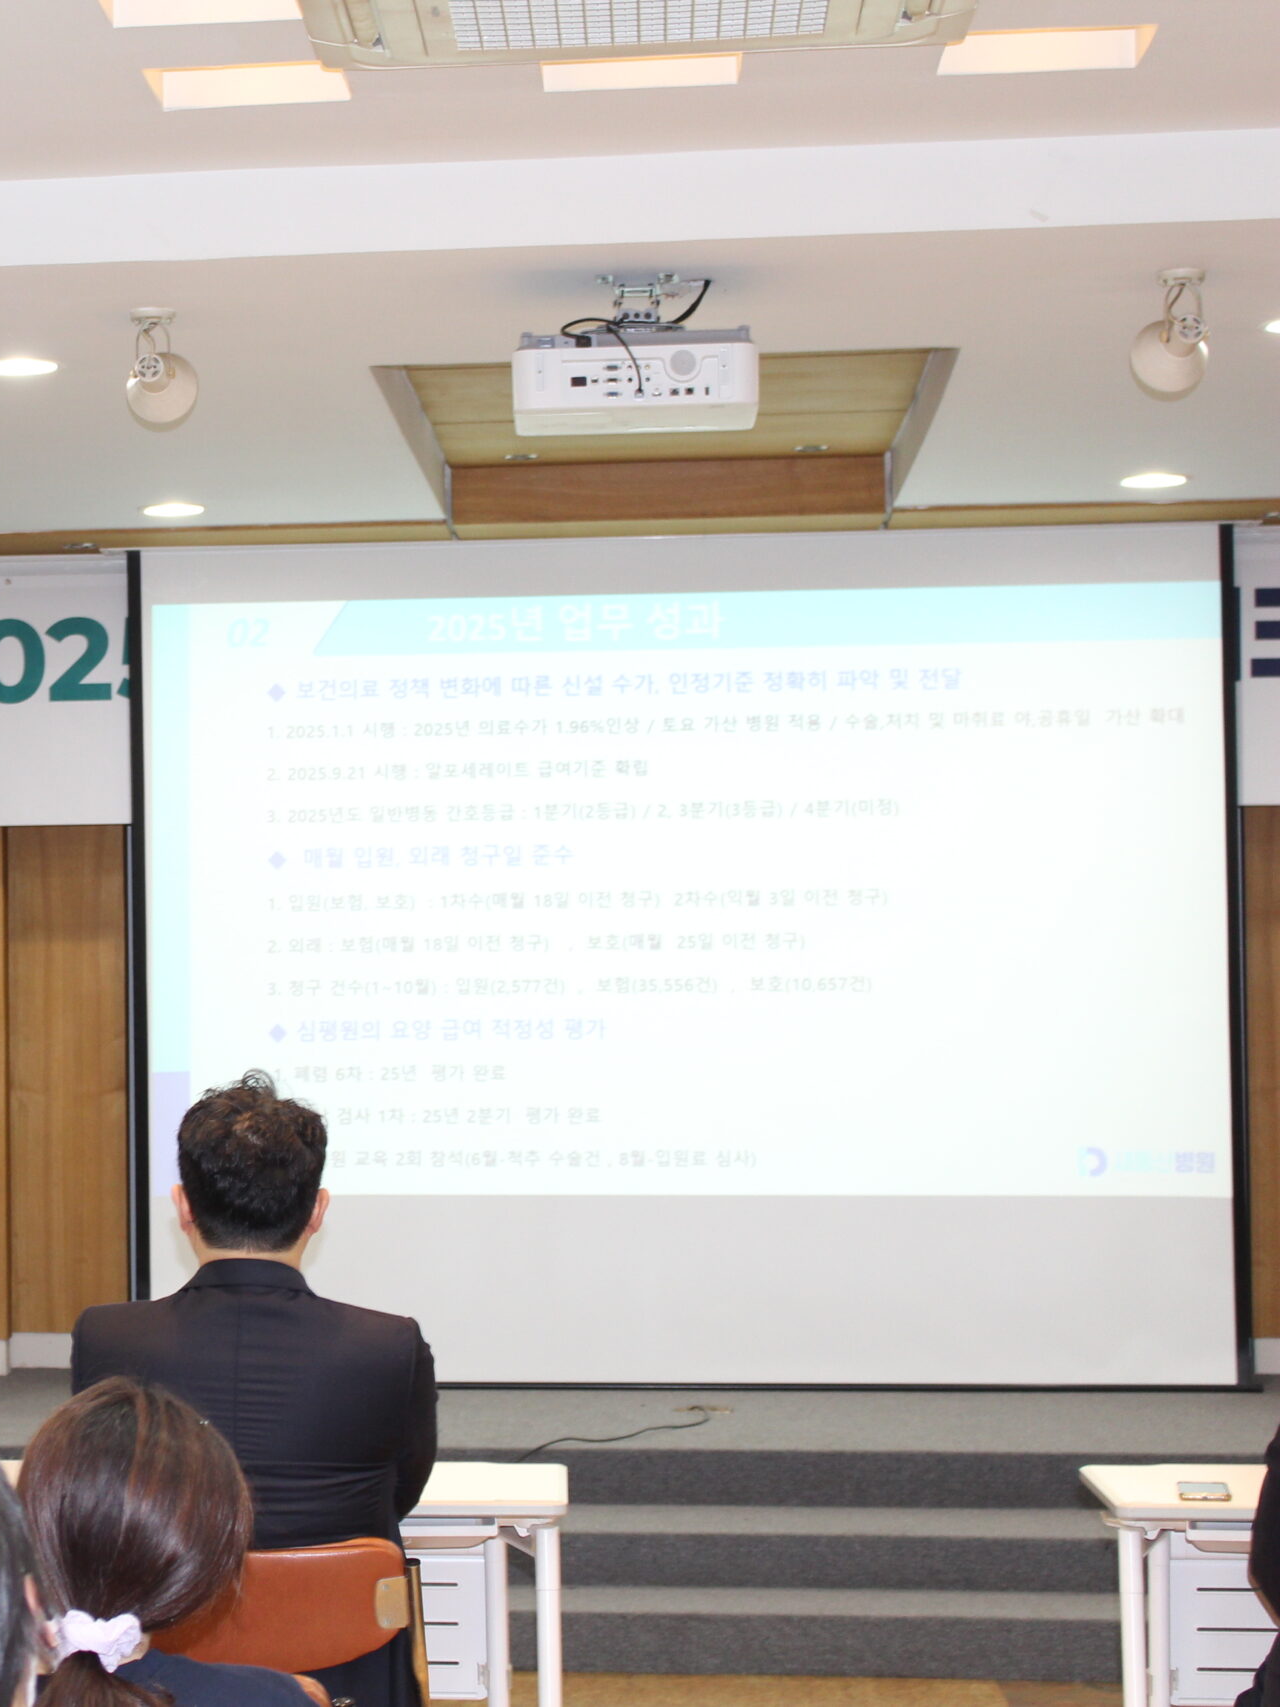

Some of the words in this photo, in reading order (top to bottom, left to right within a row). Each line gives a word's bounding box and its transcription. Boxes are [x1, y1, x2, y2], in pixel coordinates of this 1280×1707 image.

[226, 617, 271, 647] 02
[426, 604, 544, 642] 2025년
[559, 600, 634, 642] 업무
[646, 599, 726, 641] 성과
[296, 680, 380, 701] 보건의료
[389, 678, 430, 699] 정책
[440, 676, 502, 699] 변화에
[512, 674, 553, 696] 따른
[561, 674, 603, 696] 신설
[669, 671, 755, 695] 인정기준
[764, 670, 827, 692] 정확히
[836, 669, 880, 691] 파악
[889, 668, 909, 690] 및
[918, 667, 963, 691] 전달
[286, 724, 353, 739] 2025.1.1
[363, 722, 396, 740] 시행
[413, 720, 470, 738] 2025년
[478, 718, 548, 736] 의료수가
[662, 717, 696, 732] 토요
[704, 715, 739, 733] 가산
[746, 714, 780, 732] 병원
[788, 713, 822, 732] 적용
[929, 712, 944, 729] 및
[1105, 708, 1142, 727] 가산
[1150, 707, 1185, 725] 확대
[374, 763, 408, 782] 시행
[538, 760, 608, 779] 급여기준
[288, 806, 364, 824] 2025년도
[446, 803, 515, 822] 간호등급
[304, 847, 344, 869] 매월
[460, 844, 523, 867] 청구일
[531, 844, 574, 866] 준수
[375, 892, 416, 912] 보호)
[534, 891, 570, 909] 18일
[578, 890, 612, 909] 이전
[620, 890, 662, 909] 청구)
[769, 888, 797, 908] 3일
[803, 888, 839, 908] 이전
[848, 888, 889, 906] 청구)
[341, 936, 415, 954] 보험(매월
[424, 935, 459, 952] 18일
[467, 935, 502, 952] 이전
[509, 934, 549, 952] 청구)
[587, 933, 662, 952] 보호(매월
[676, 932, 714, 952] 25일
[721, 932, 756, 952] 이전
[765, 932, 806, 952] 청구)
[289, 979, 322, 997] 청구
[296, 1020, 381, 1043] 심평원의
[390, 1020, 432, 1040] 요양
[440, 1018, 483, 1041] 급여
[492, 1018, 554, 1040] 적정성
[564, 1018, 607, 1040] 평가
[335, 1064, 364, 1083] 6차
[380, 1064, 416, 1083] 25년
[432, 1064, 464, 1082] 평가
[472, 1064, 506, 1083] 완료
[337, 1107, 371, 1125] 검사
[378, 1107, 405, 1125] 1차
[422, 1107, 459, 1125] 25년
[466, 1107, 511, 1126] 2분기
[526, 1107, 560, 1125] 평가
[568, 1107, 602, 1125] 완료
[354, 1150, 388, 1168] 교육
[396, 1150, 422, 1168] 2회
[716, 1149, 757, 1168] 심사)
